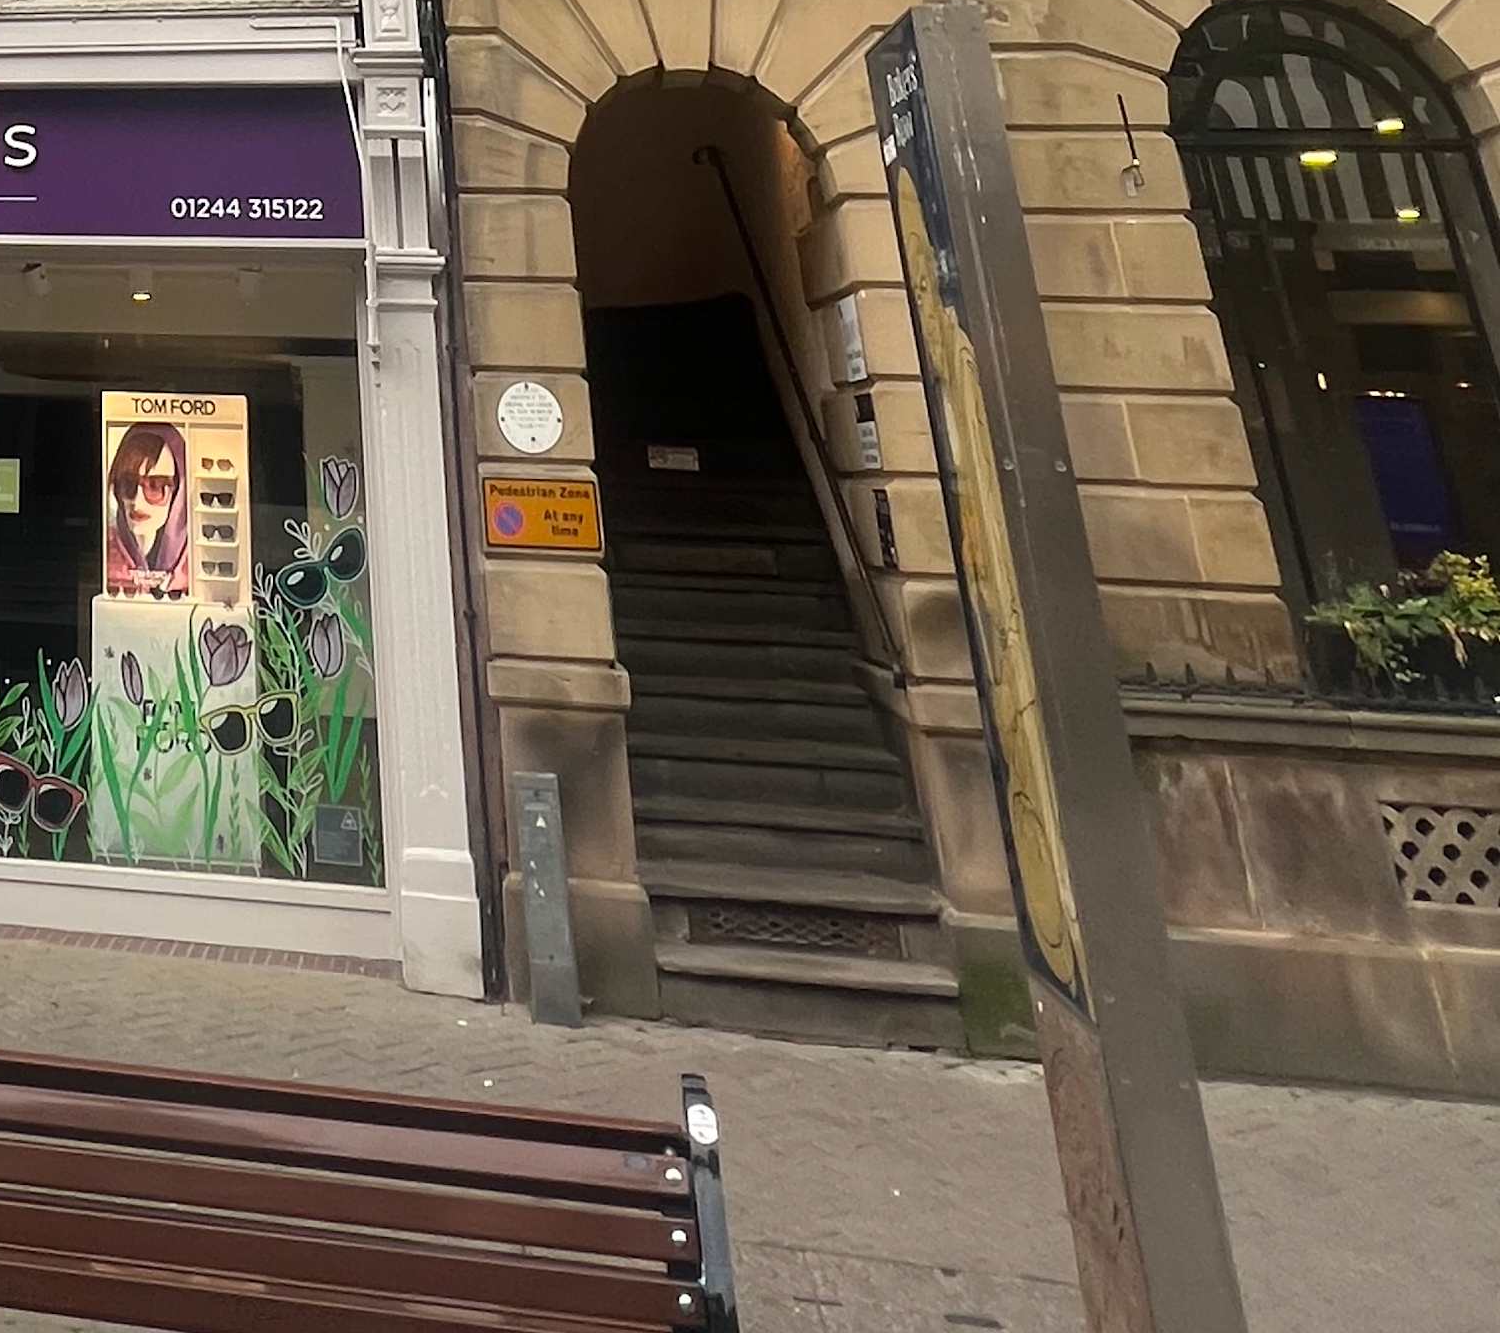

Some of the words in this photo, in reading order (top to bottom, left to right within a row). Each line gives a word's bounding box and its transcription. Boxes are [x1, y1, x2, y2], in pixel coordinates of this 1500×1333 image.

[170, 198, 241, 218] 01244
[248, 198, 324, 220] 315122
[131, 398, 167, 414] TOM
[170, 399, 216, 416] FORD
[489, 484, 556, 498] Pedestrian
[559, 487, 591, 500] Zone
[544, 509, 558, 522] At
[562, 512, 583, 525] any
[551, 524, 579, 537] time
